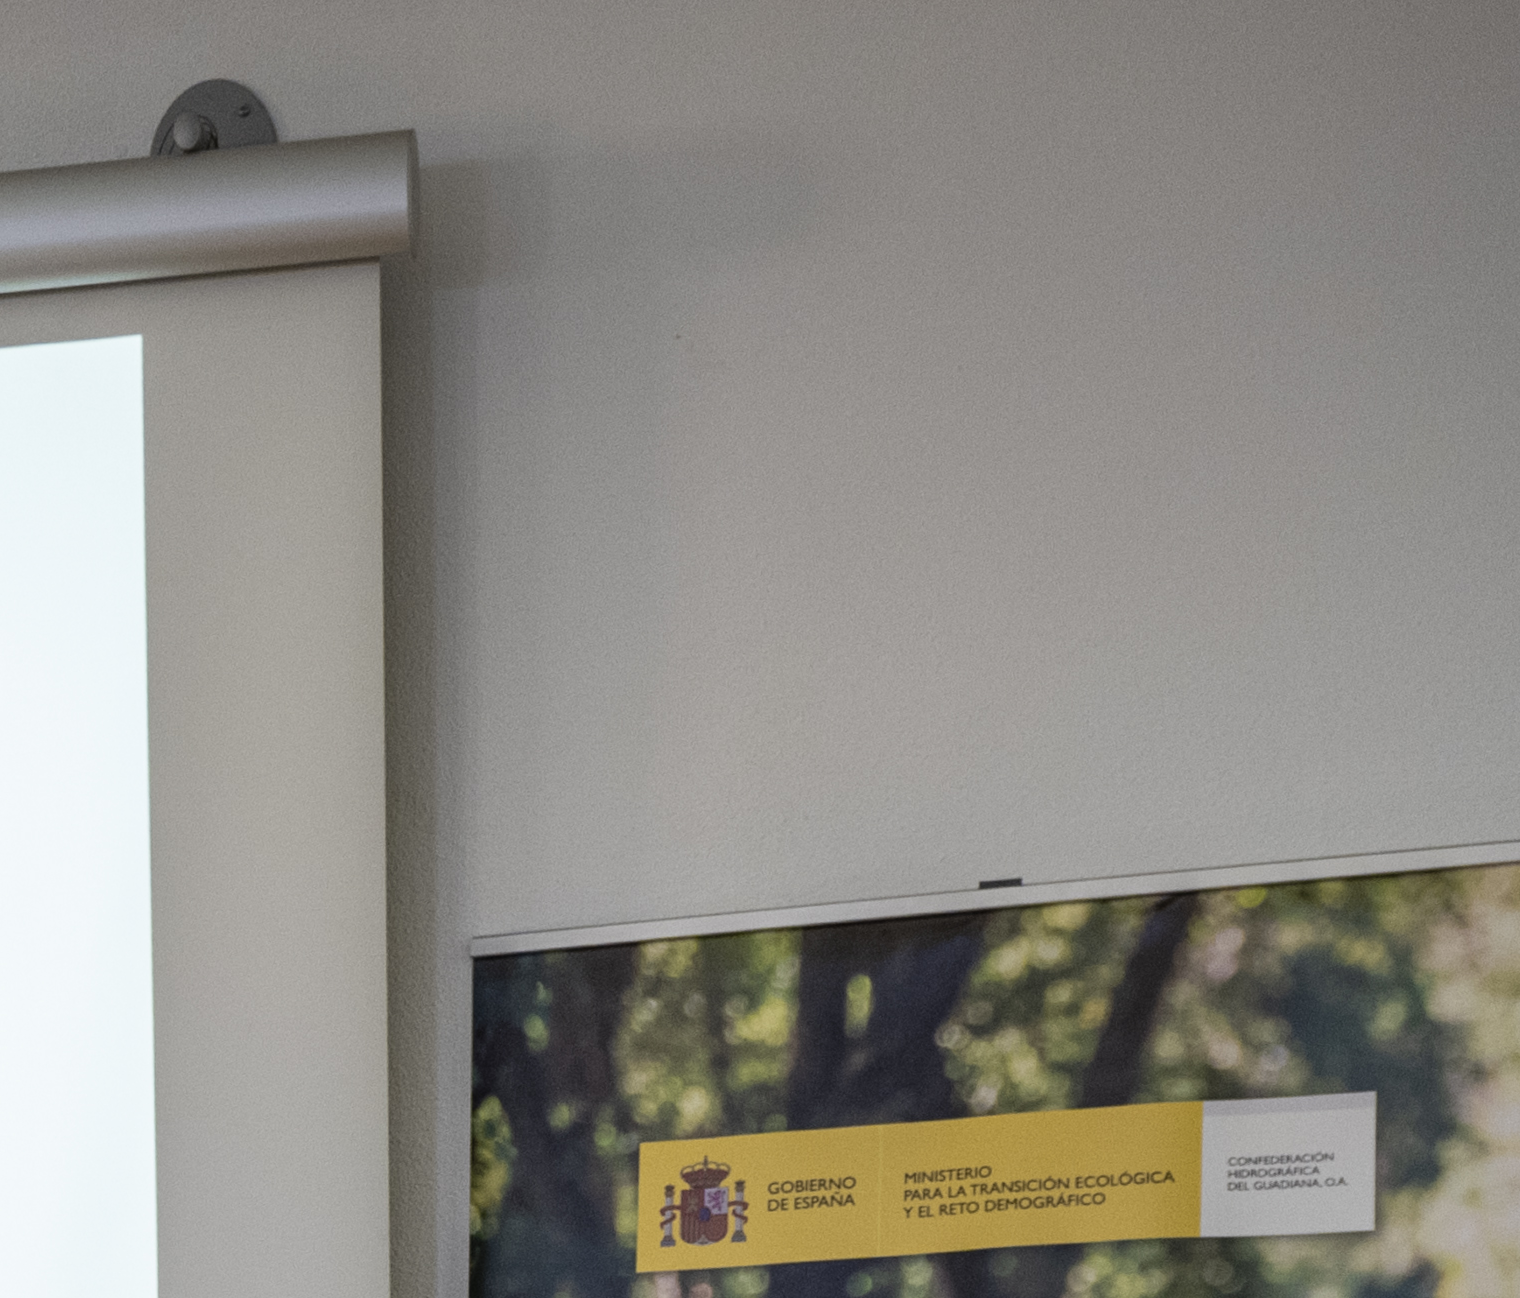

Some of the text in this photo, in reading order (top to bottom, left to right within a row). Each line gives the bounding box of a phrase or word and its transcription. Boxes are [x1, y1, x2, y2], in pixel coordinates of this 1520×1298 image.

[904, 1165, 992, 1184] MINISTERIO
[767, 1176, 857, 1195] GOBIERNO
[904, 1170, 1175, 1202] PARA LA TRANSICIÓN ECOLÓGICA
[767, 1192, 856, 1212] DE ESPAÑA
[903, 1192, 1106, 1219] Y EL RETO DEMOGRÁFICO
